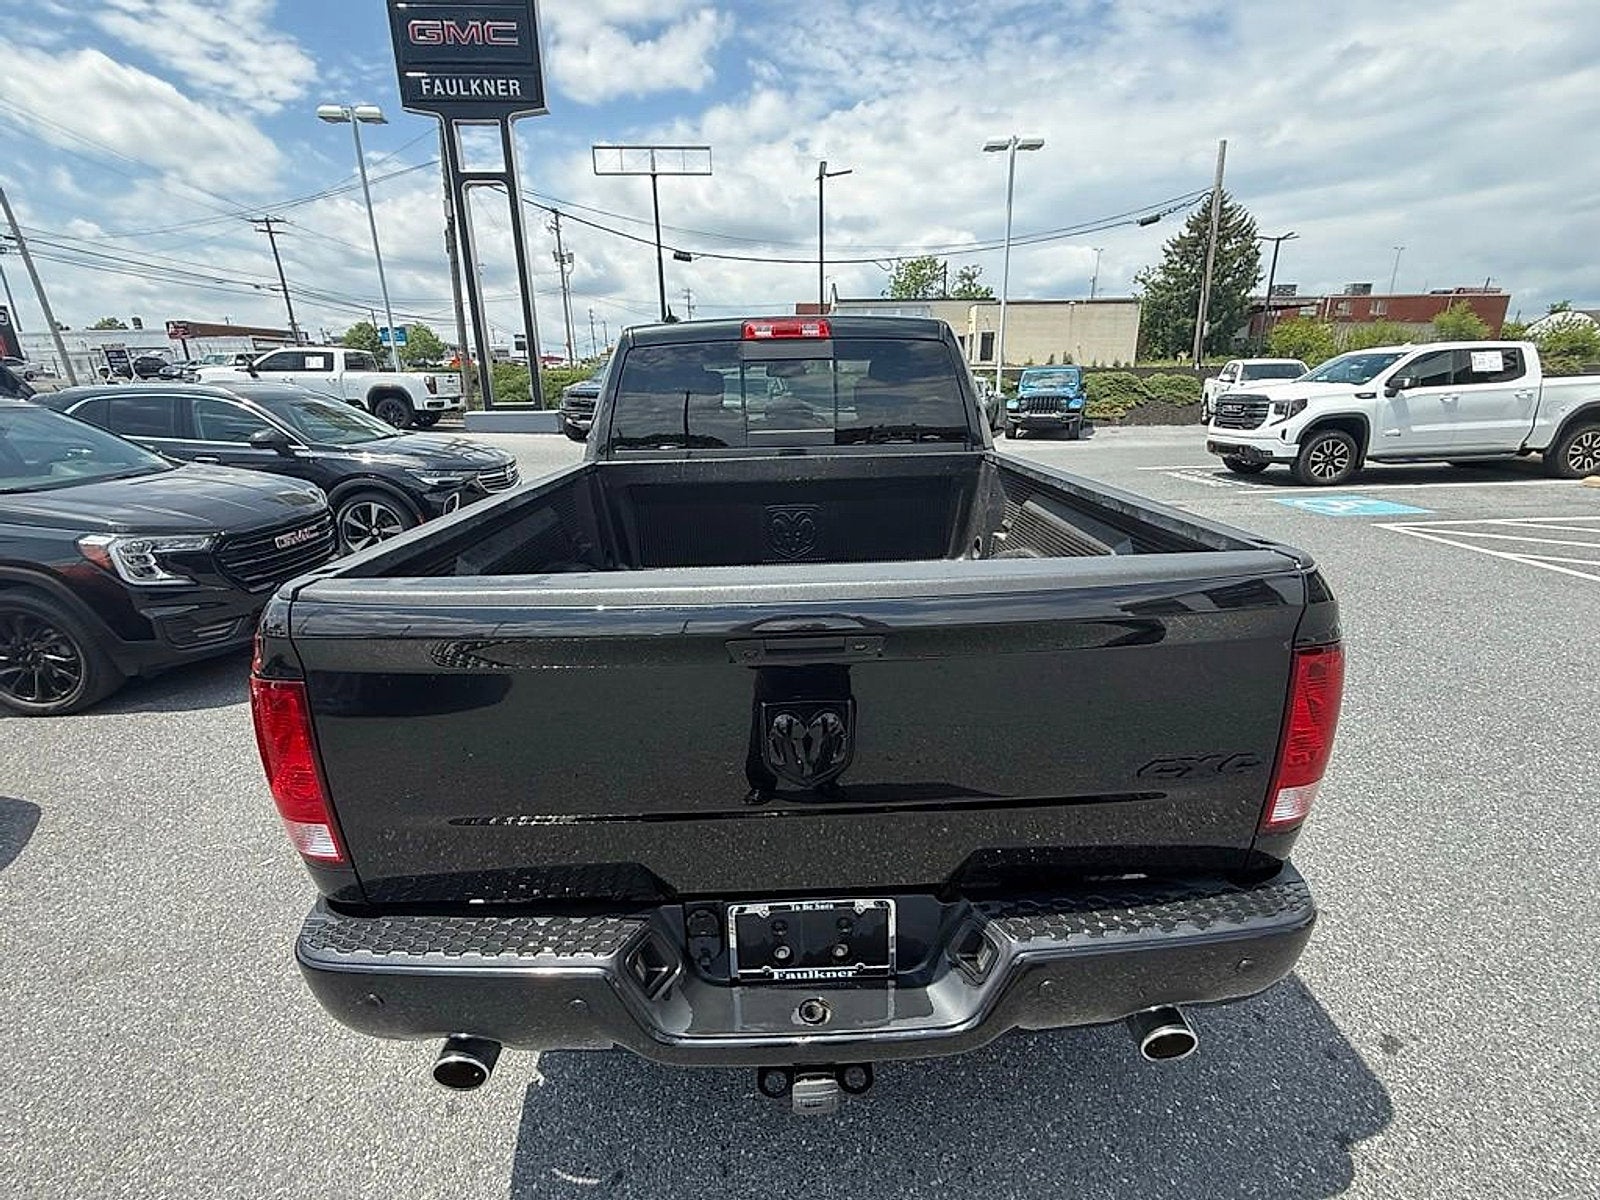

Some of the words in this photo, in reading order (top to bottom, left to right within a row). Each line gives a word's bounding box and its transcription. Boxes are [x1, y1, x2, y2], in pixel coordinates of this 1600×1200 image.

[408, 20, 518, 45] GMC
[421, 79, 521, 95] FAULKNER
[773, 970, 857, 980] Faulkner
